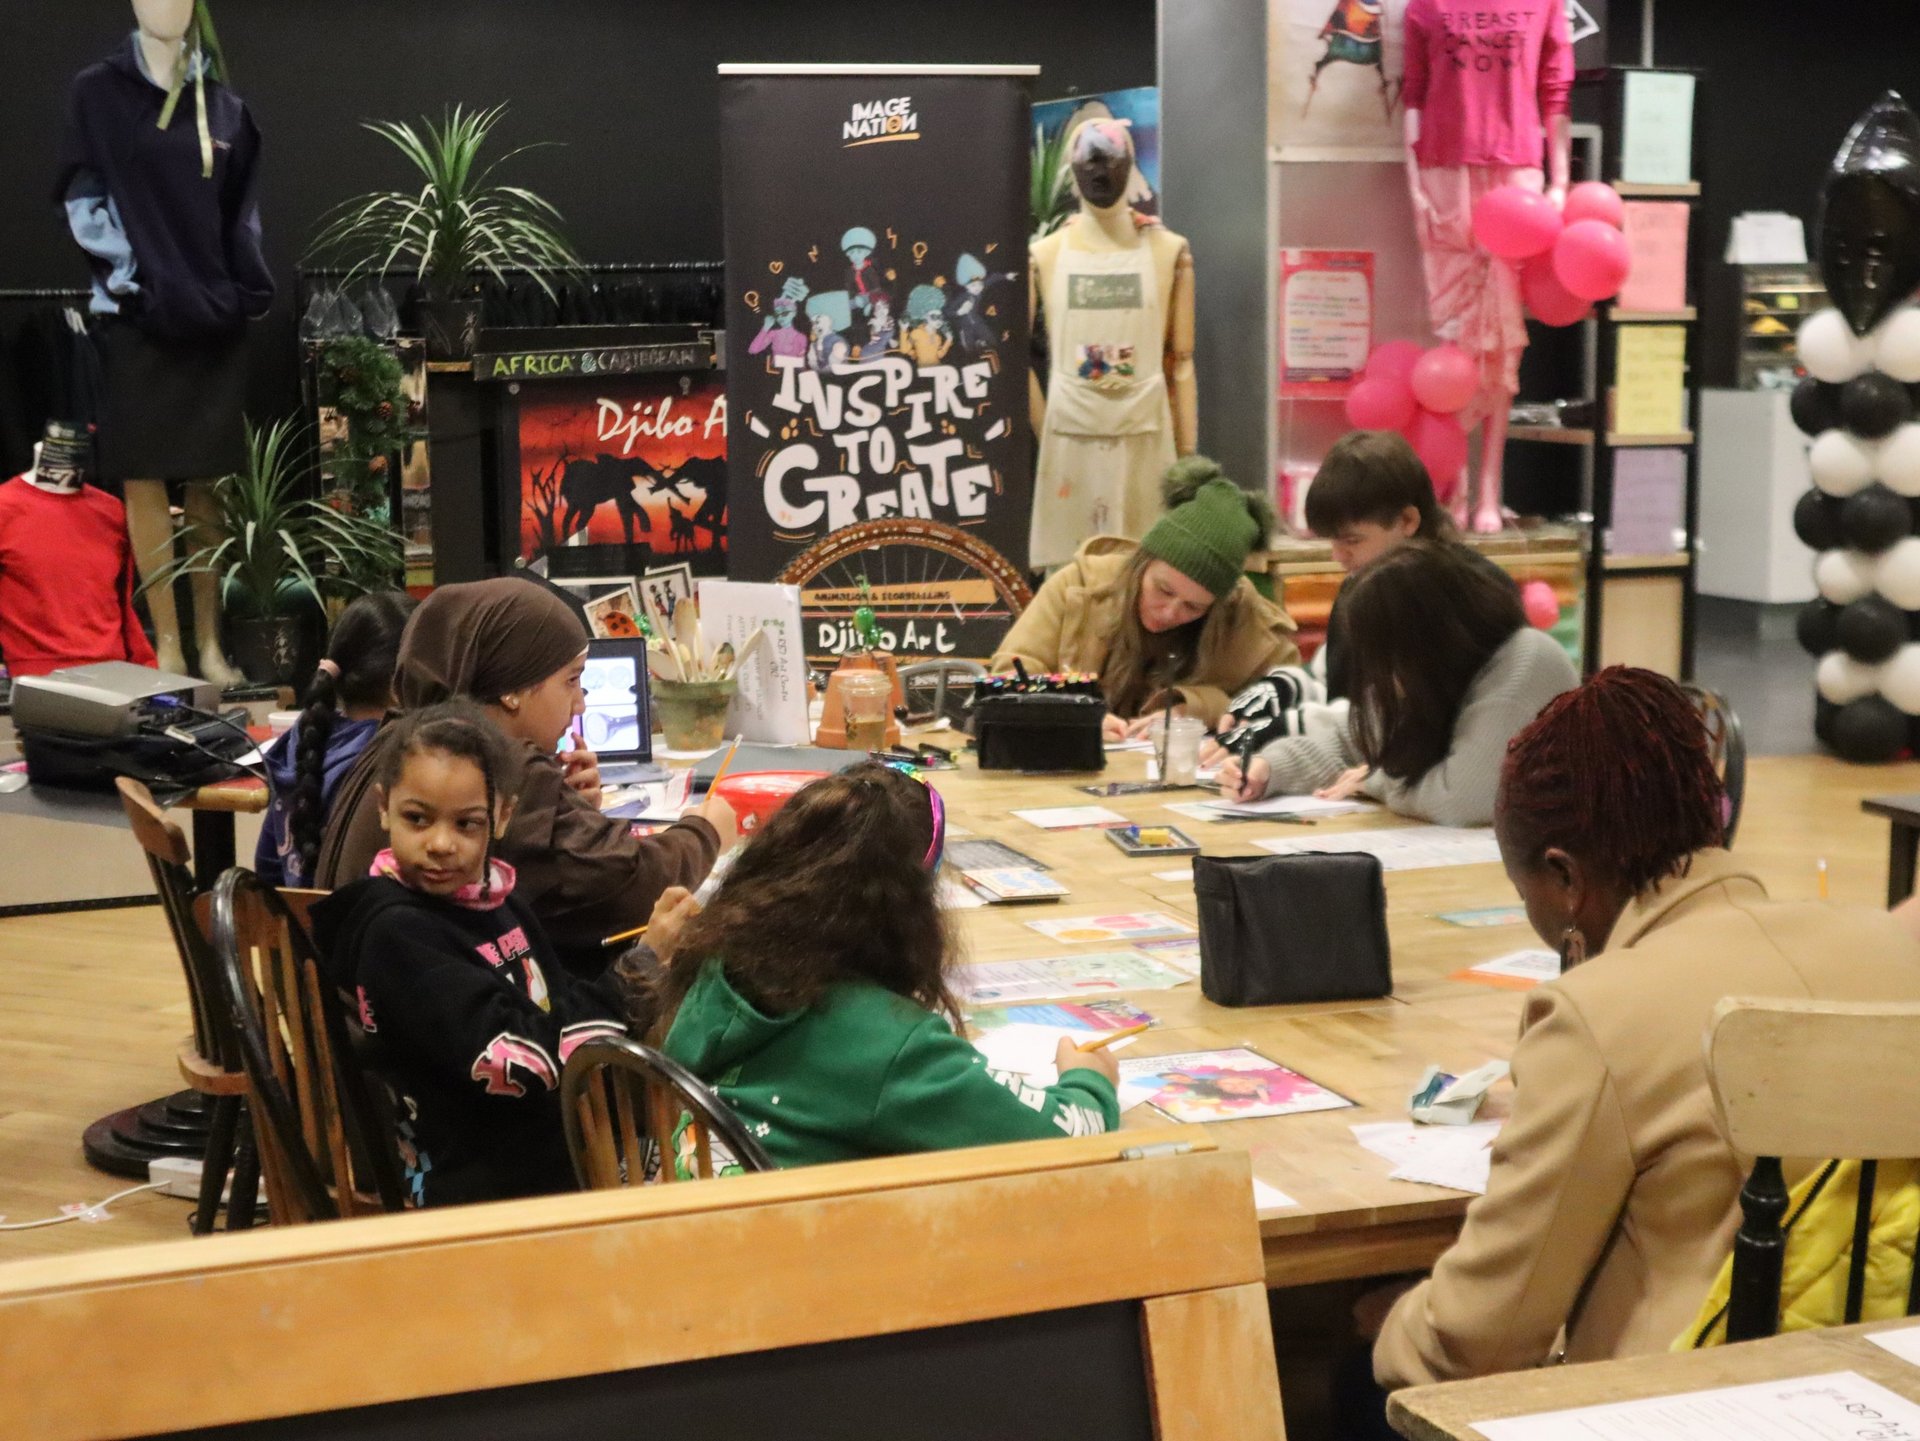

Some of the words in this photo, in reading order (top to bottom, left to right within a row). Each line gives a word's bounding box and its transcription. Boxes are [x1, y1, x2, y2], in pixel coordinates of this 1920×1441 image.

[1441, 11, 1536, 29] BREAST
[843, 112, 918, 139] NATION
[852, 96, 911, 121] IMAGE
[493, 354, 574, 376] AFRICA
[581, 352, 597, 373] &
[772, 354, 992, 440] INSPIRE
[597, 395, 693, 454] Djibo
[833, 426, 896, 474] TO
[763, 438, 993, 533] CREATE
[819, 620, 897, 654] Djio
[902, 620, 956, 653] Art
